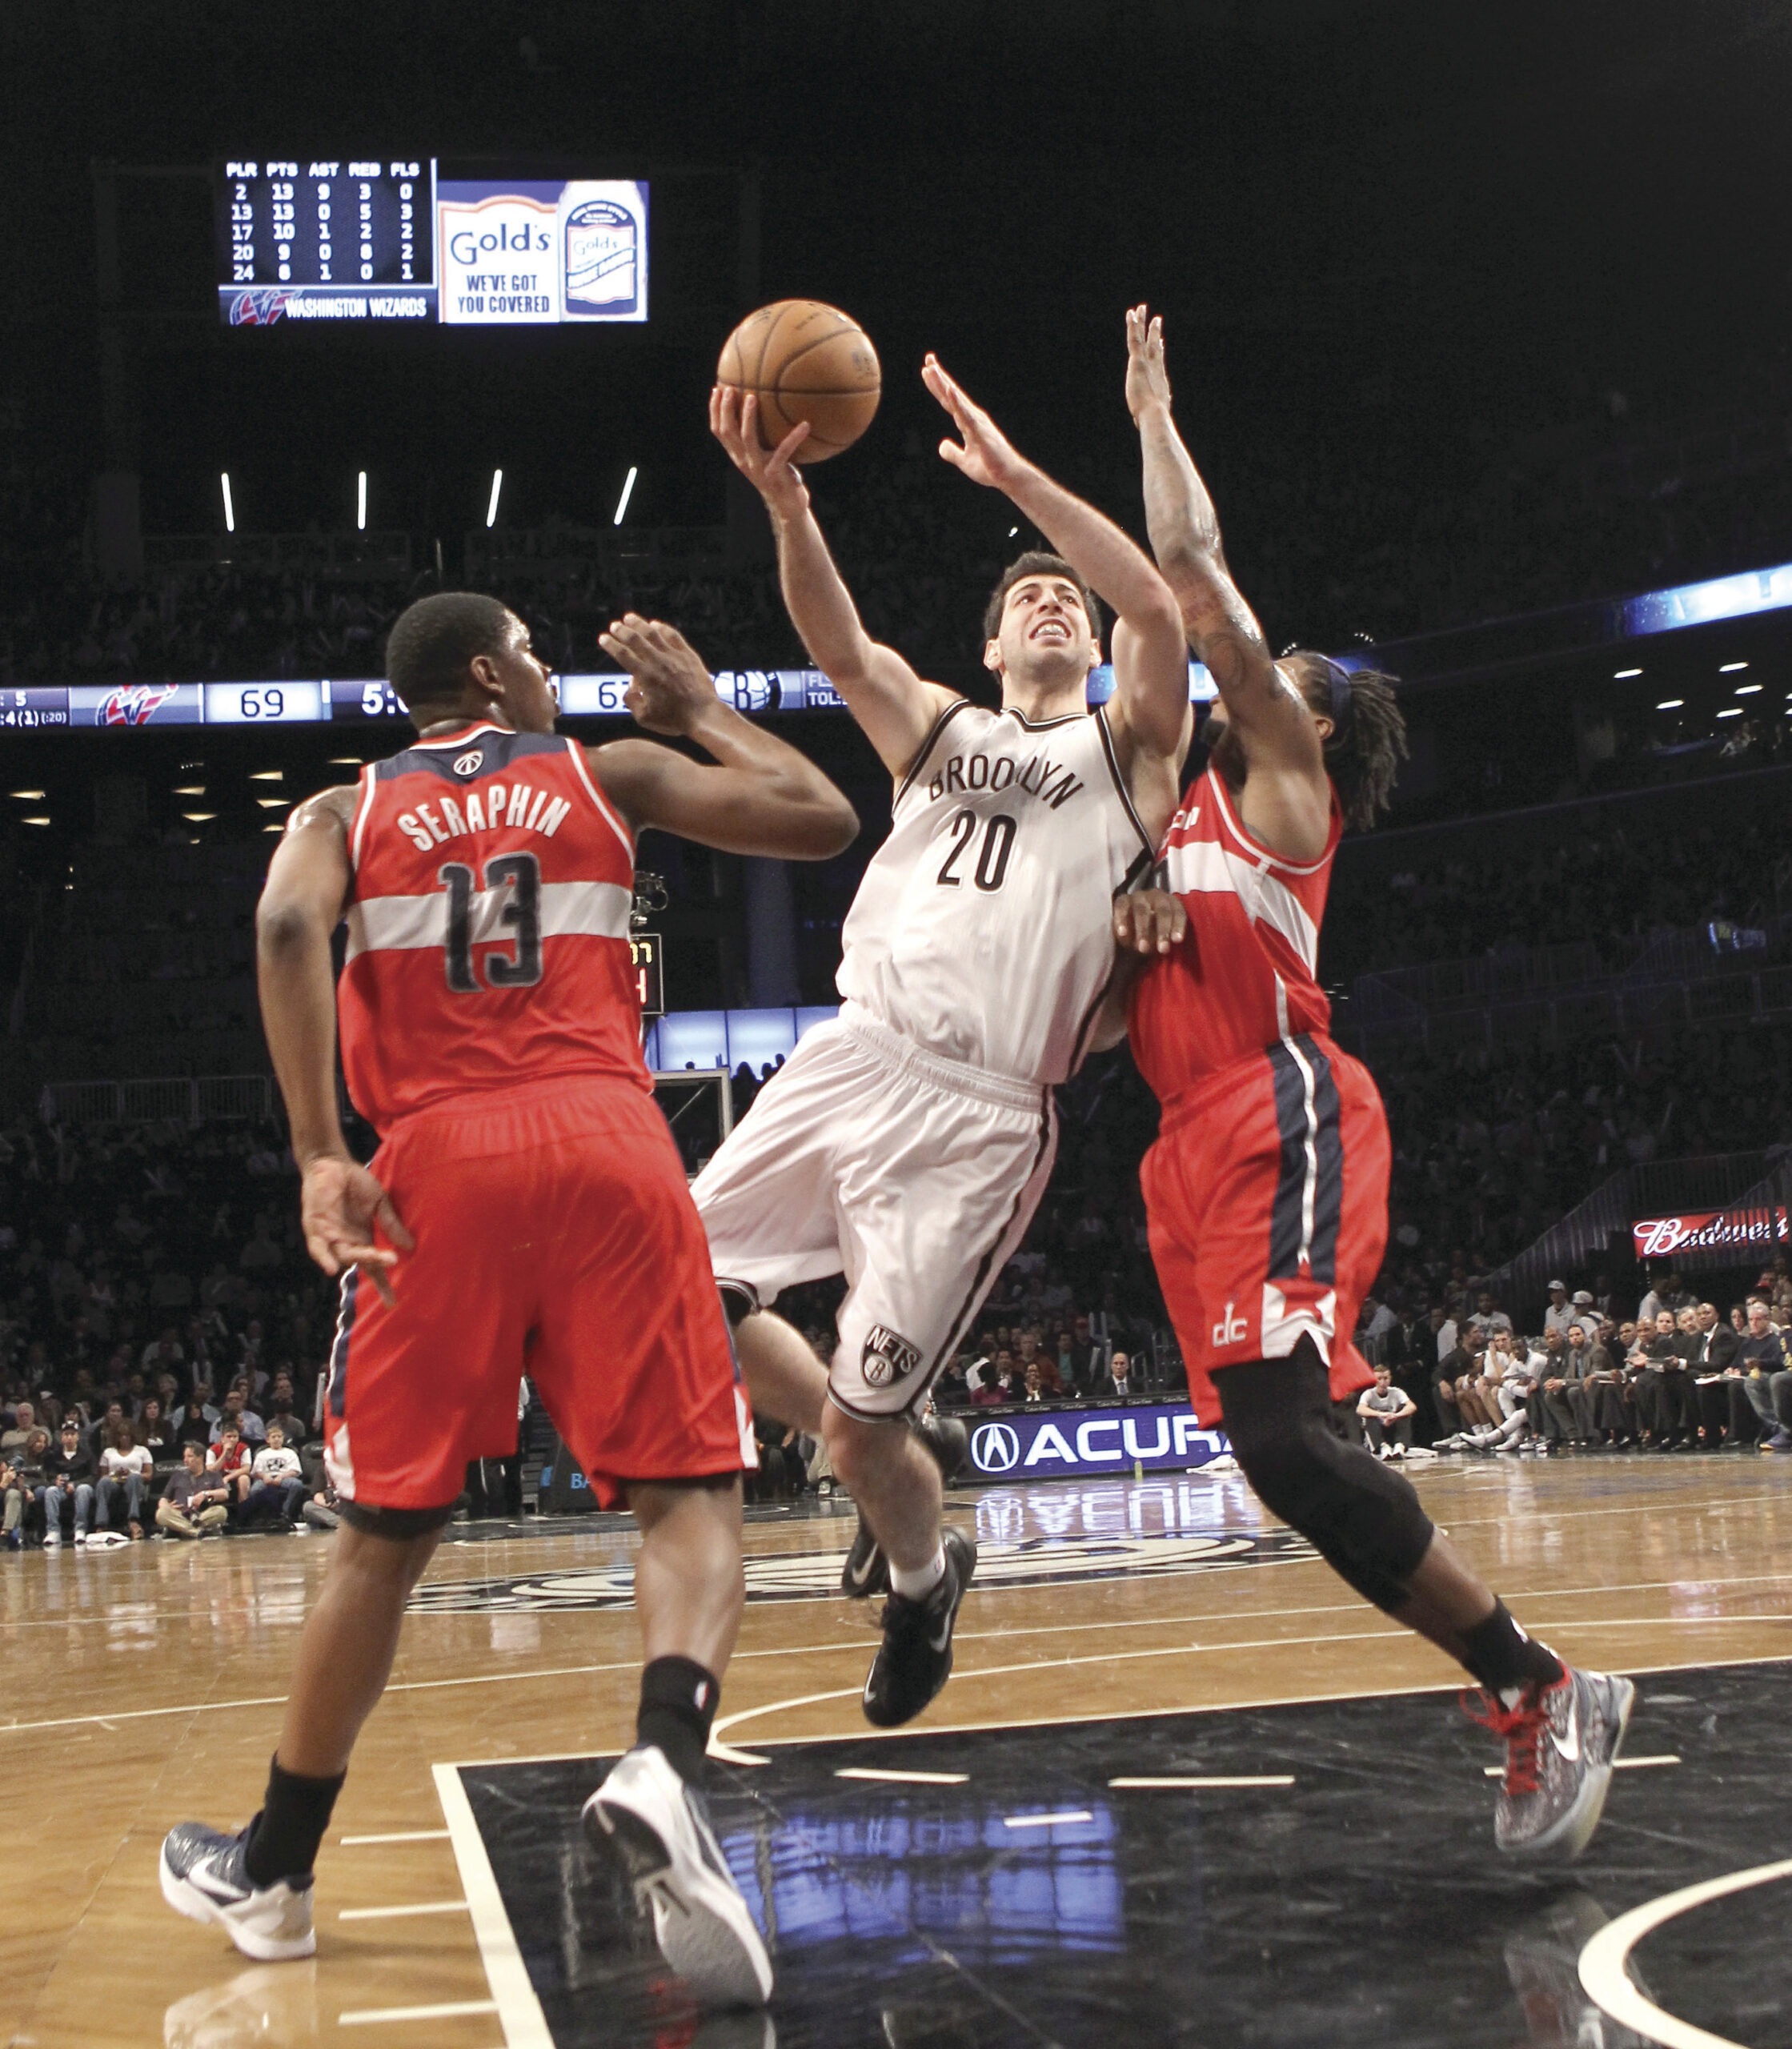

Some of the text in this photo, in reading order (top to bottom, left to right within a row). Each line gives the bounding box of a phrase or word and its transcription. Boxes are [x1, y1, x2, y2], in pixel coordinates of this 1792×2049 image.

[226, 162, 420, 178] PLR PTS AST REB FLS
[235, 182, 413, 200] 2 13 9 3 0
[231, 202, 413, 221] 13 13 0 5 3
[232, 222, 413, 241] 17 10 1 2 2
[233, 243, 255, 261] 20
[278, 243, 291, 261] 9
[319, 243, 332, 261] 0
[401, 243, 413, 260] 2
[450, 223, 551, 266] Gold's
[233, 264, 255, 281] 24
[319, 263, 332, 280] 1
[360, 263, 373, 280] 0
[402, 263, 414, 280] 1
[467, 275, 538, 292] WE'VE GOT
[284, 297, 427, 318] WASHINGTON WIZARDS
[458, 295, 550, 313] YOU COVERED
[241, 689, 284, 717] 69
[929, 754, 1084, 811] BROOLYN
[397, 784, 571, 852] SERAPHIN
[936, 809, 1018, 892] 20
[437, 851, 545, 994] 13
[1212, 1301, 1249, 1349] dc
[865, 1325, 919, 1373] NETS
